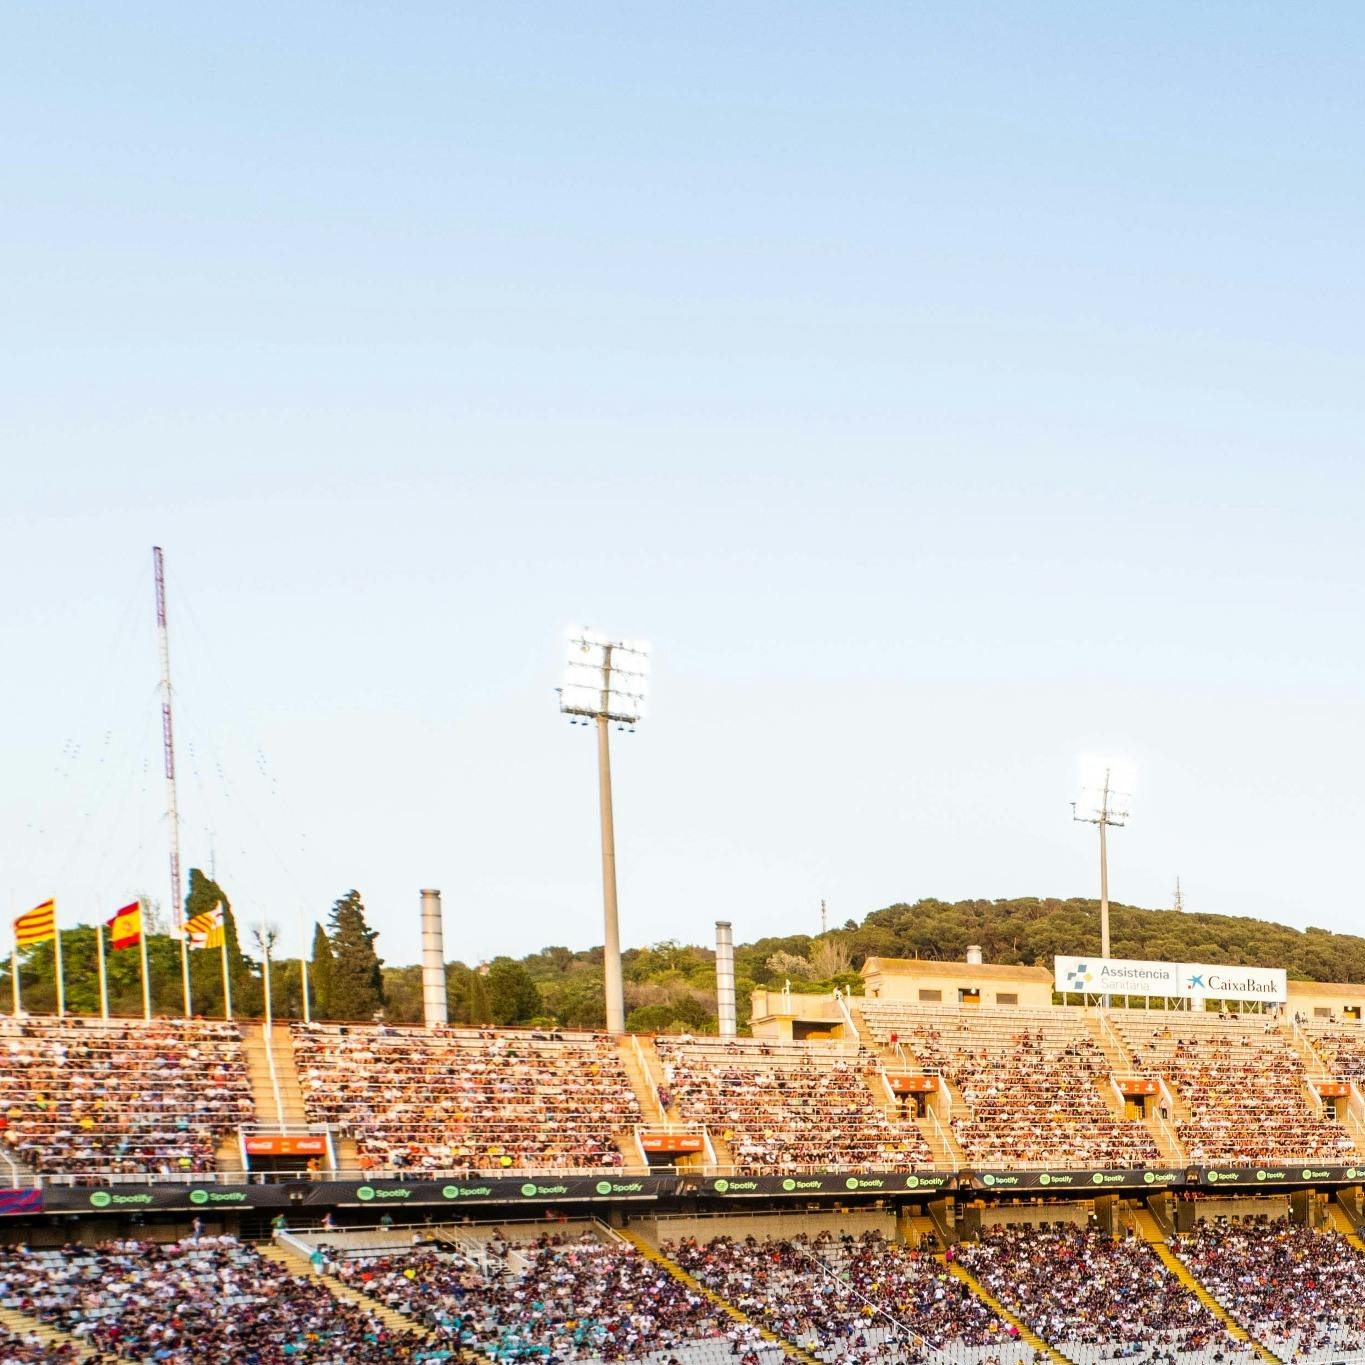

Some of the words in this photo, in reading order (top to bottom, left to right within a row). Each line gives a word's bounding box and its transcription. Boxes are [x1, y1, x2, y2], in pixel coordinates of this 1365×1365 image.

[1208, 975, 1277, 993] CaixaBank
[1050, 1175, 1073, 1184] Spotify
[1104, 1174, 1125, 1183] Spotify
[1155, 1173, 1177, 1183] Spotify
[1219, 1172, 1239, 1181] Spotify
[1266, 1171, 1287, 1180] Spotify
[1312, 1170, 1331, 1179] Spotify
[795, 1180, 822, 1190] Spotify
[859, 1179, 884, 1188] Spotify
[920, 1177, 945, 1187] Spotify
[995, 1175, 1019, 1185] Spotify
[537, 1185, 568, 1196] Spotify
[613, 1183, 642, 1193] Spotify
[729, 1181, 758, 1191] Spotify
[209, 1191, 248, 1202] Spotify
[376, 1188, 411, 1199] Spotify
[460, 1186, 492, 1197] Spotify
[111, 1193, 153, 1204] Spotify
